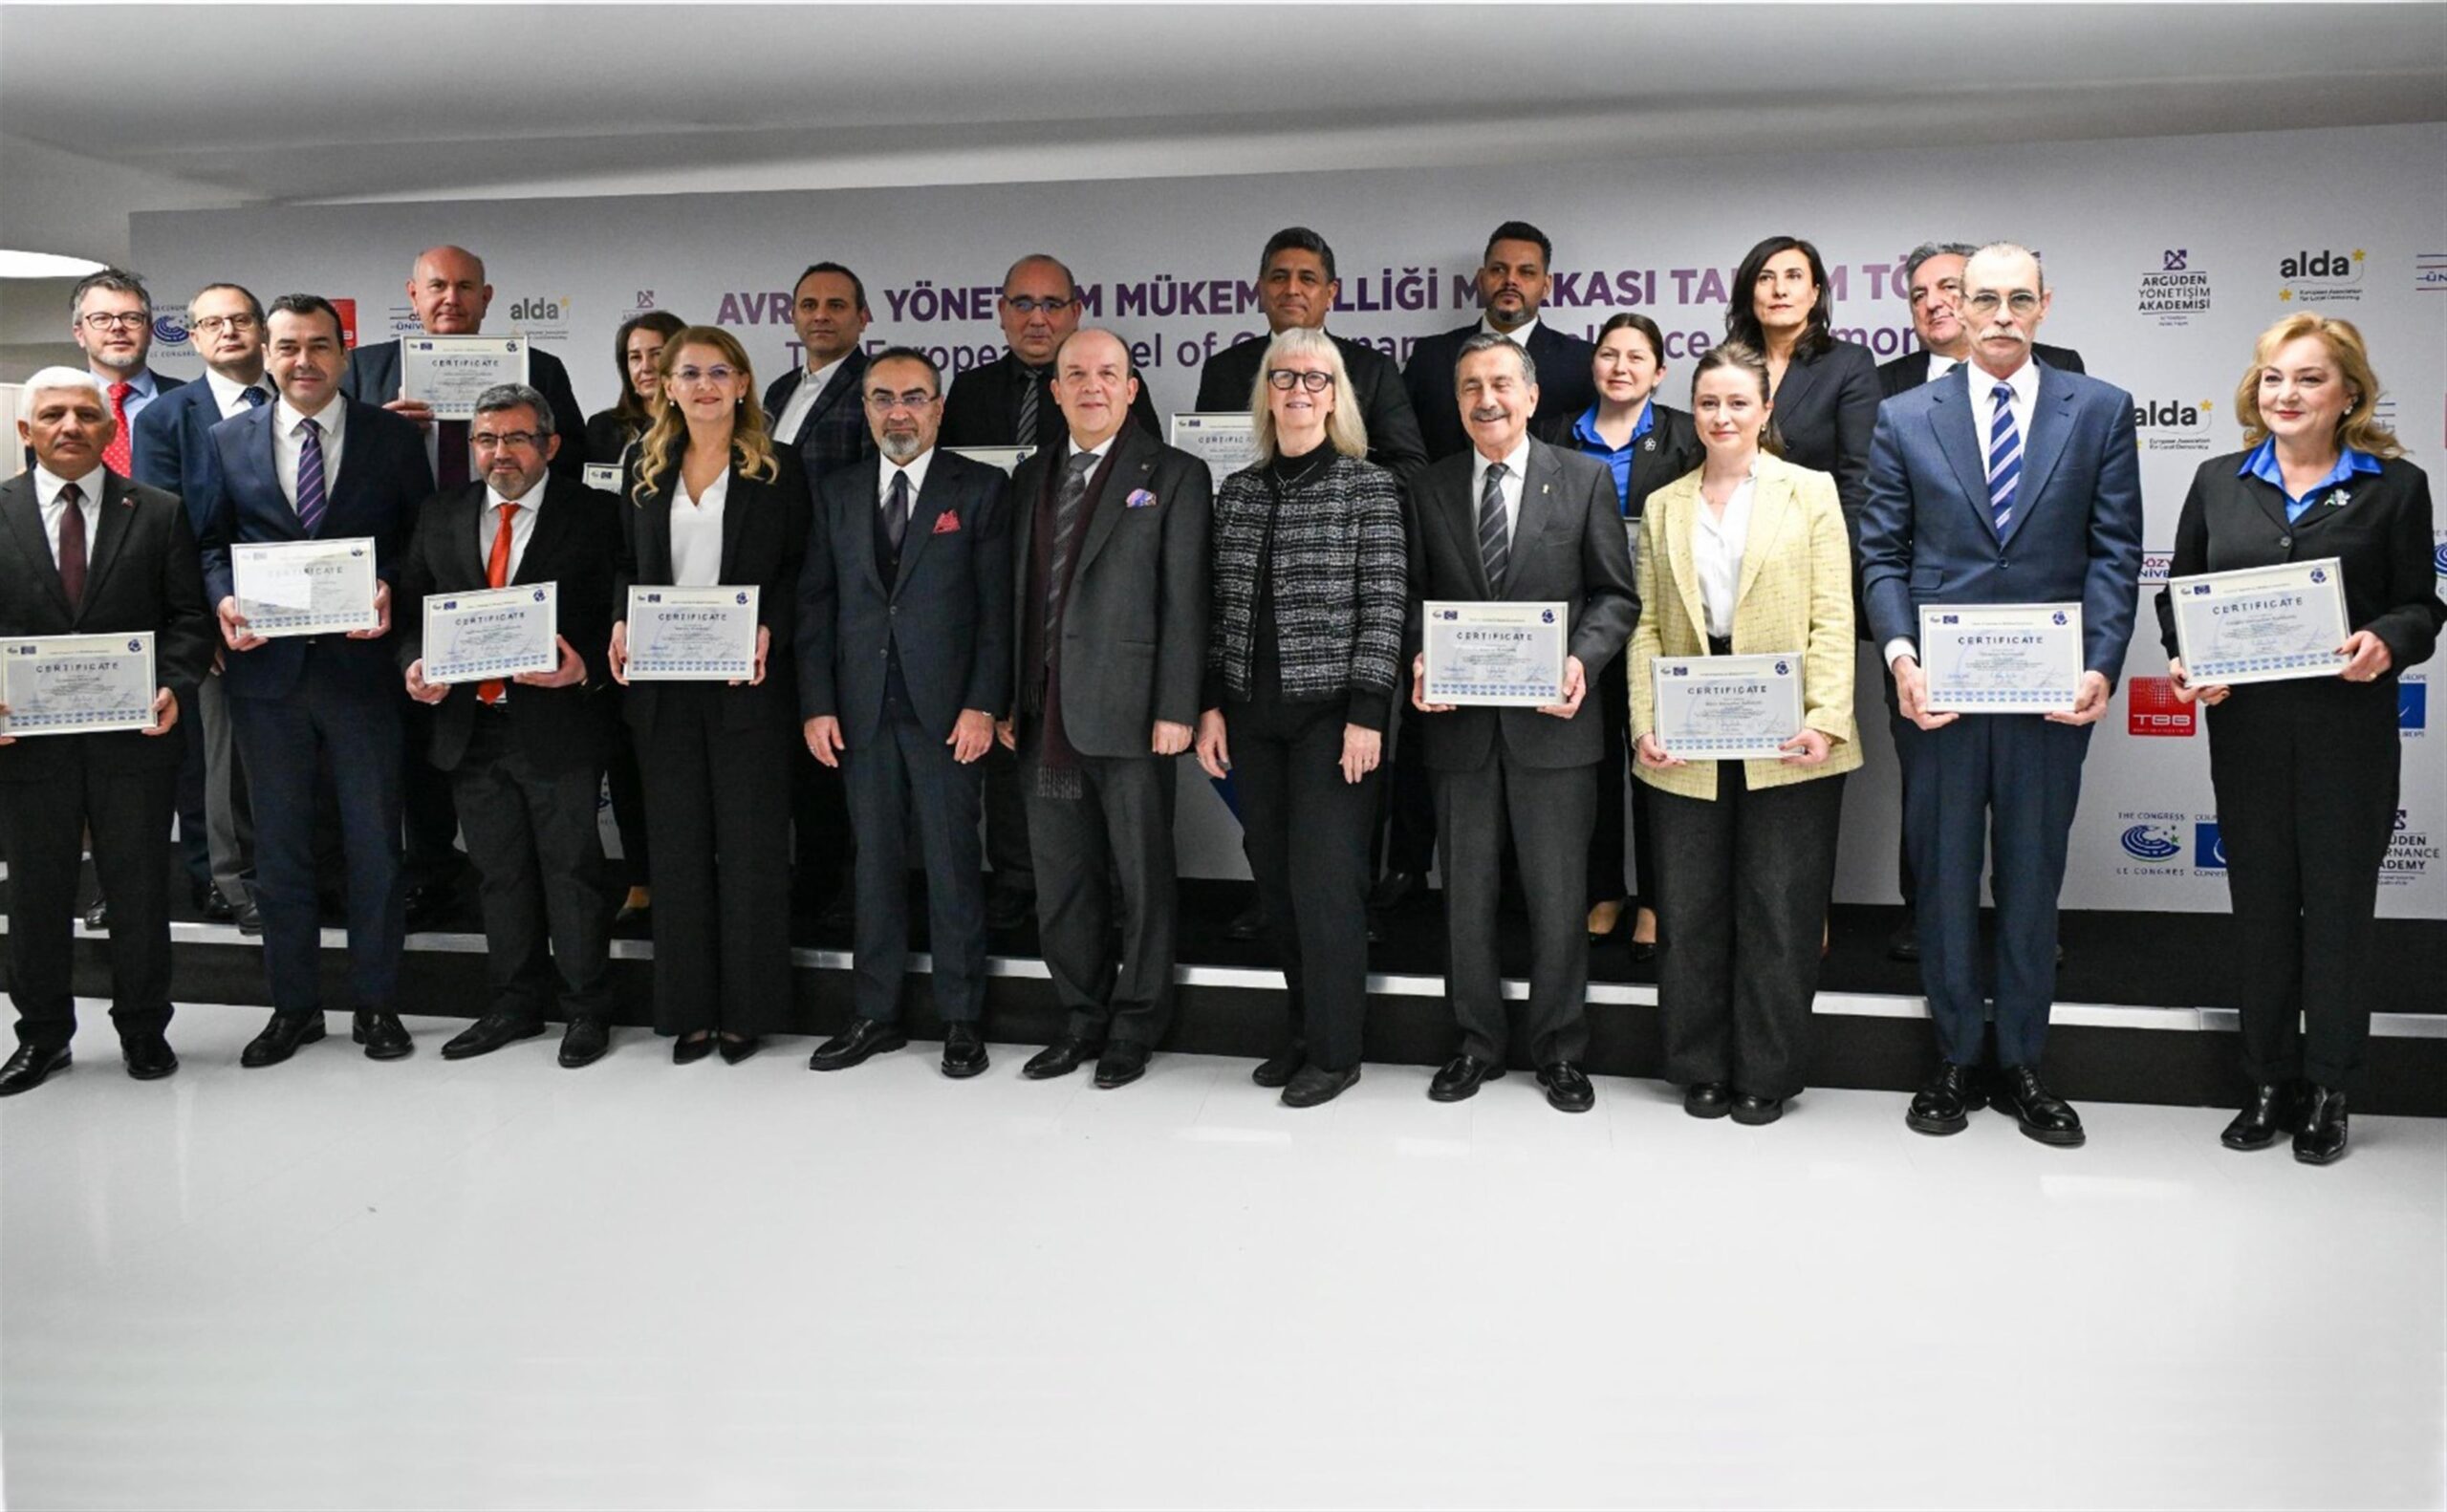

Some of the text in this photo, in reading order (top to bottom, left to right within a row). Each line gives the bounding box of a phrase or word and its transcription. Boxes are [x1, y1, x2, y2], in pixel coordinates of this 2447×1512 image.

[2280, 250, 2350, 278] alda
[2142, 275, 2207, 287] ARGÜDEN
[883, 281, 1102, 322] YÖNEM
[1116, 268, 1438, 316] MÜKEMLLİĞİ
[1454, 270, 1656, 310] MKASI
[2138, 286, 2210, 299] YÖNETİŞİM
[510, 297, 559, 320] alda
[1177, 333, 1217, 366] of
[2134, 400, 2197, 426] alda
[2212, 597, 2304, 615] CERTIFICATE
[455, 612, 525, 626] CERTIFICATE
[1457, 632, 1532, 641] CERTIFICATE
[1958, 637, 2044, 645] CERTIFICATE
[36, 661, 119, 673] CERTIFICATE
[1687, 685, 1767, 695] CERTIFICATE
[2133, 714, 2191, 726] TBB
[2137, 812, 2185, 821] CONGRESS
[2386, 848, 2439, 858] RNANCE
